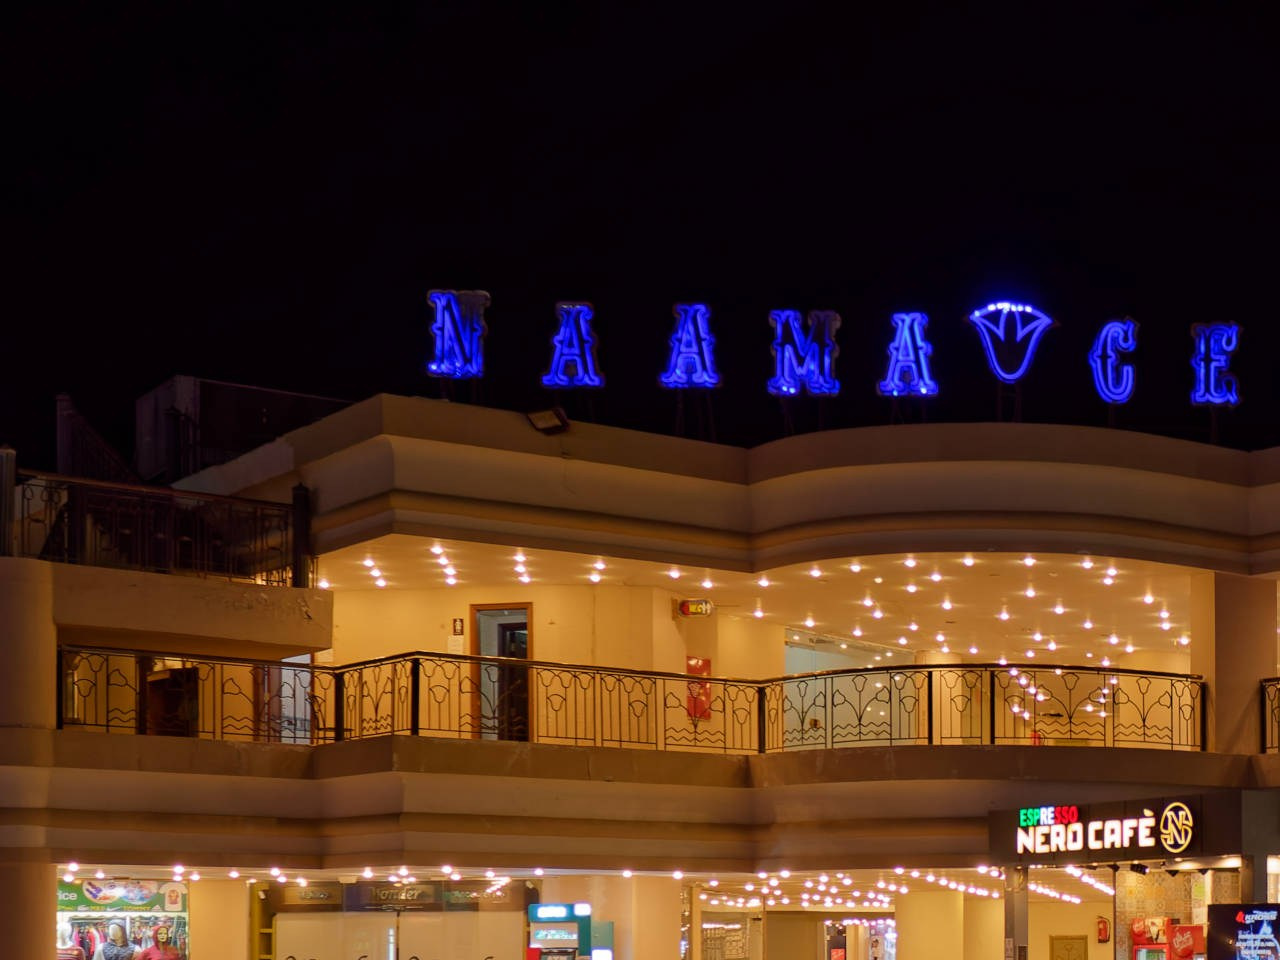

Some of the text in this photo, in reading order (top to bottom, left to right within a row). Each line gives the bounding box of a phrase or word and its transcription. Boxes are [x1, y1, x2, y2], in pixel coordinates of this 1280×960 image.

[427, 288, 938, 397] NAAMA
[1020, 806, 1078, 826] ESPRESSO
[1017, 822, 1084, 854] NERO
